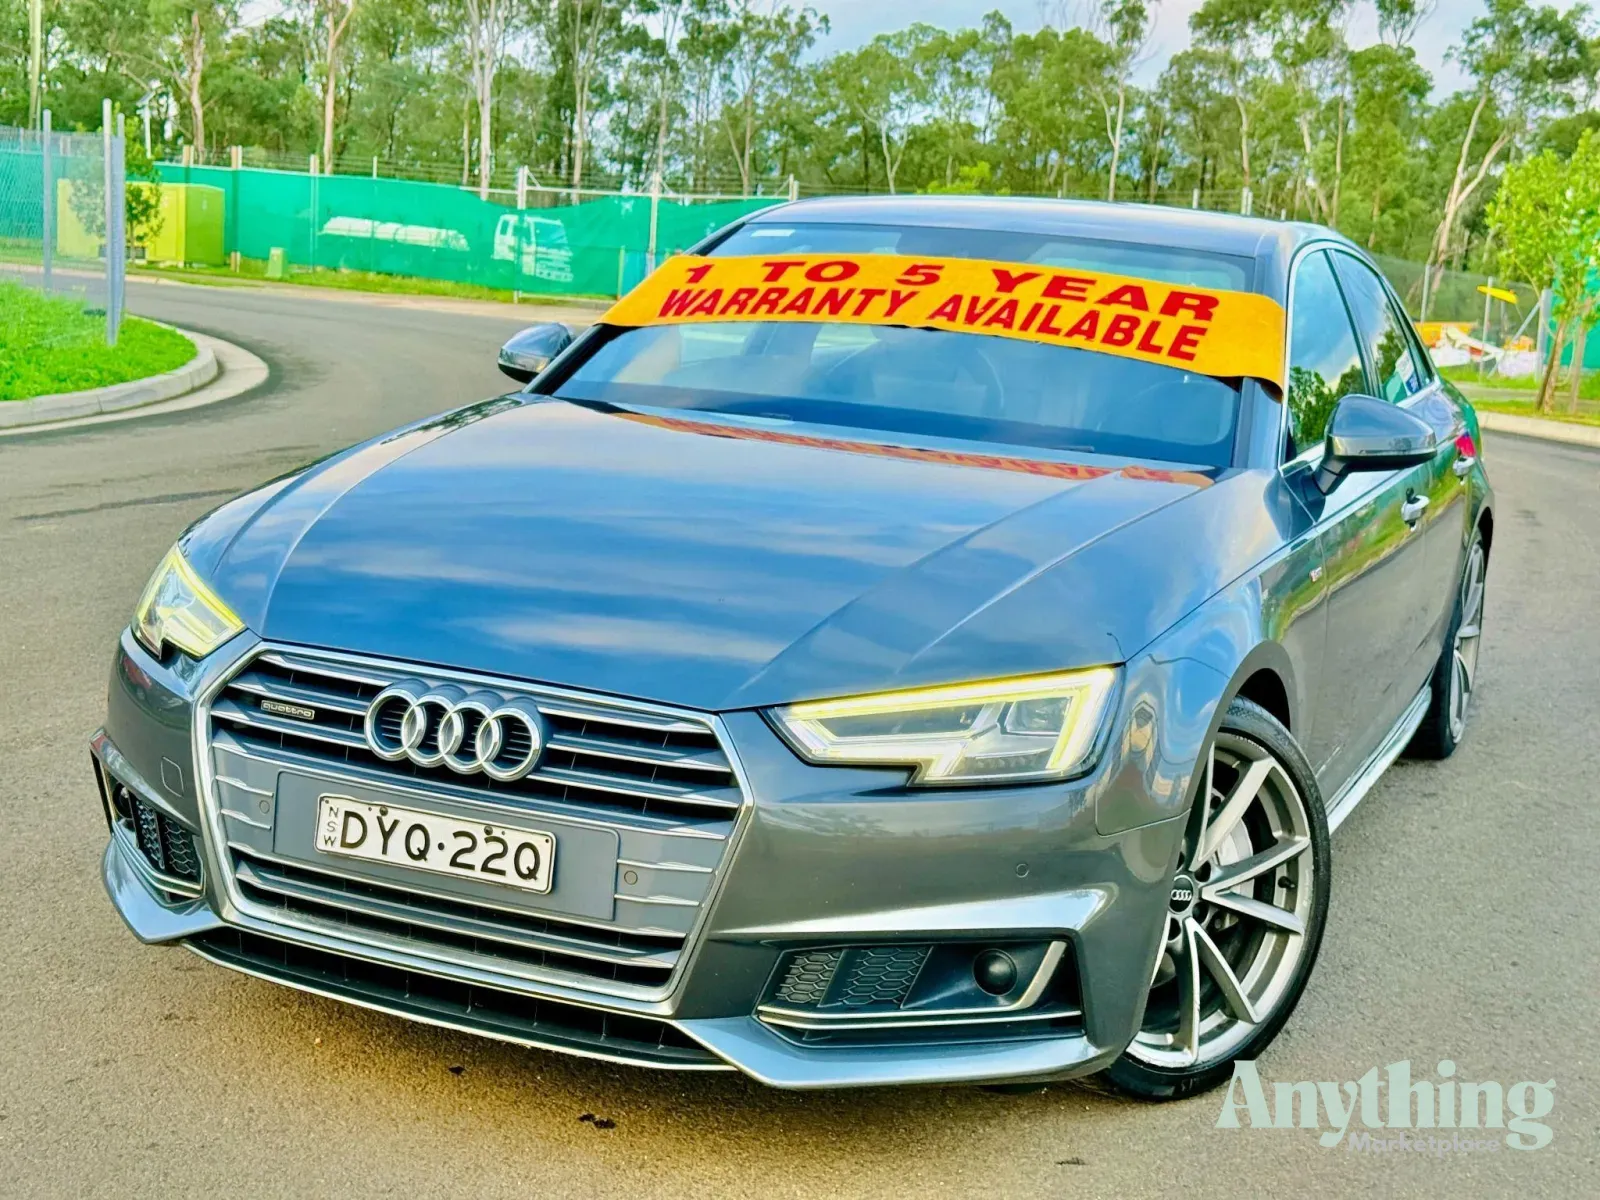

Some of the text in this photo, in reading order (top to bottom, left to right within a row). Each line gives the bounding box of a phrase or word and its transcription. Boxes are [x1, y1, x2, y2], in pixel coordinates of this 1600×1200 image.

[687, 260, 1220, 322] 1 TO 5 YEAR
[657, 287, 1208, 361] WARRANTY AVAILABLE
[262, 702, 312, 717] quattro
